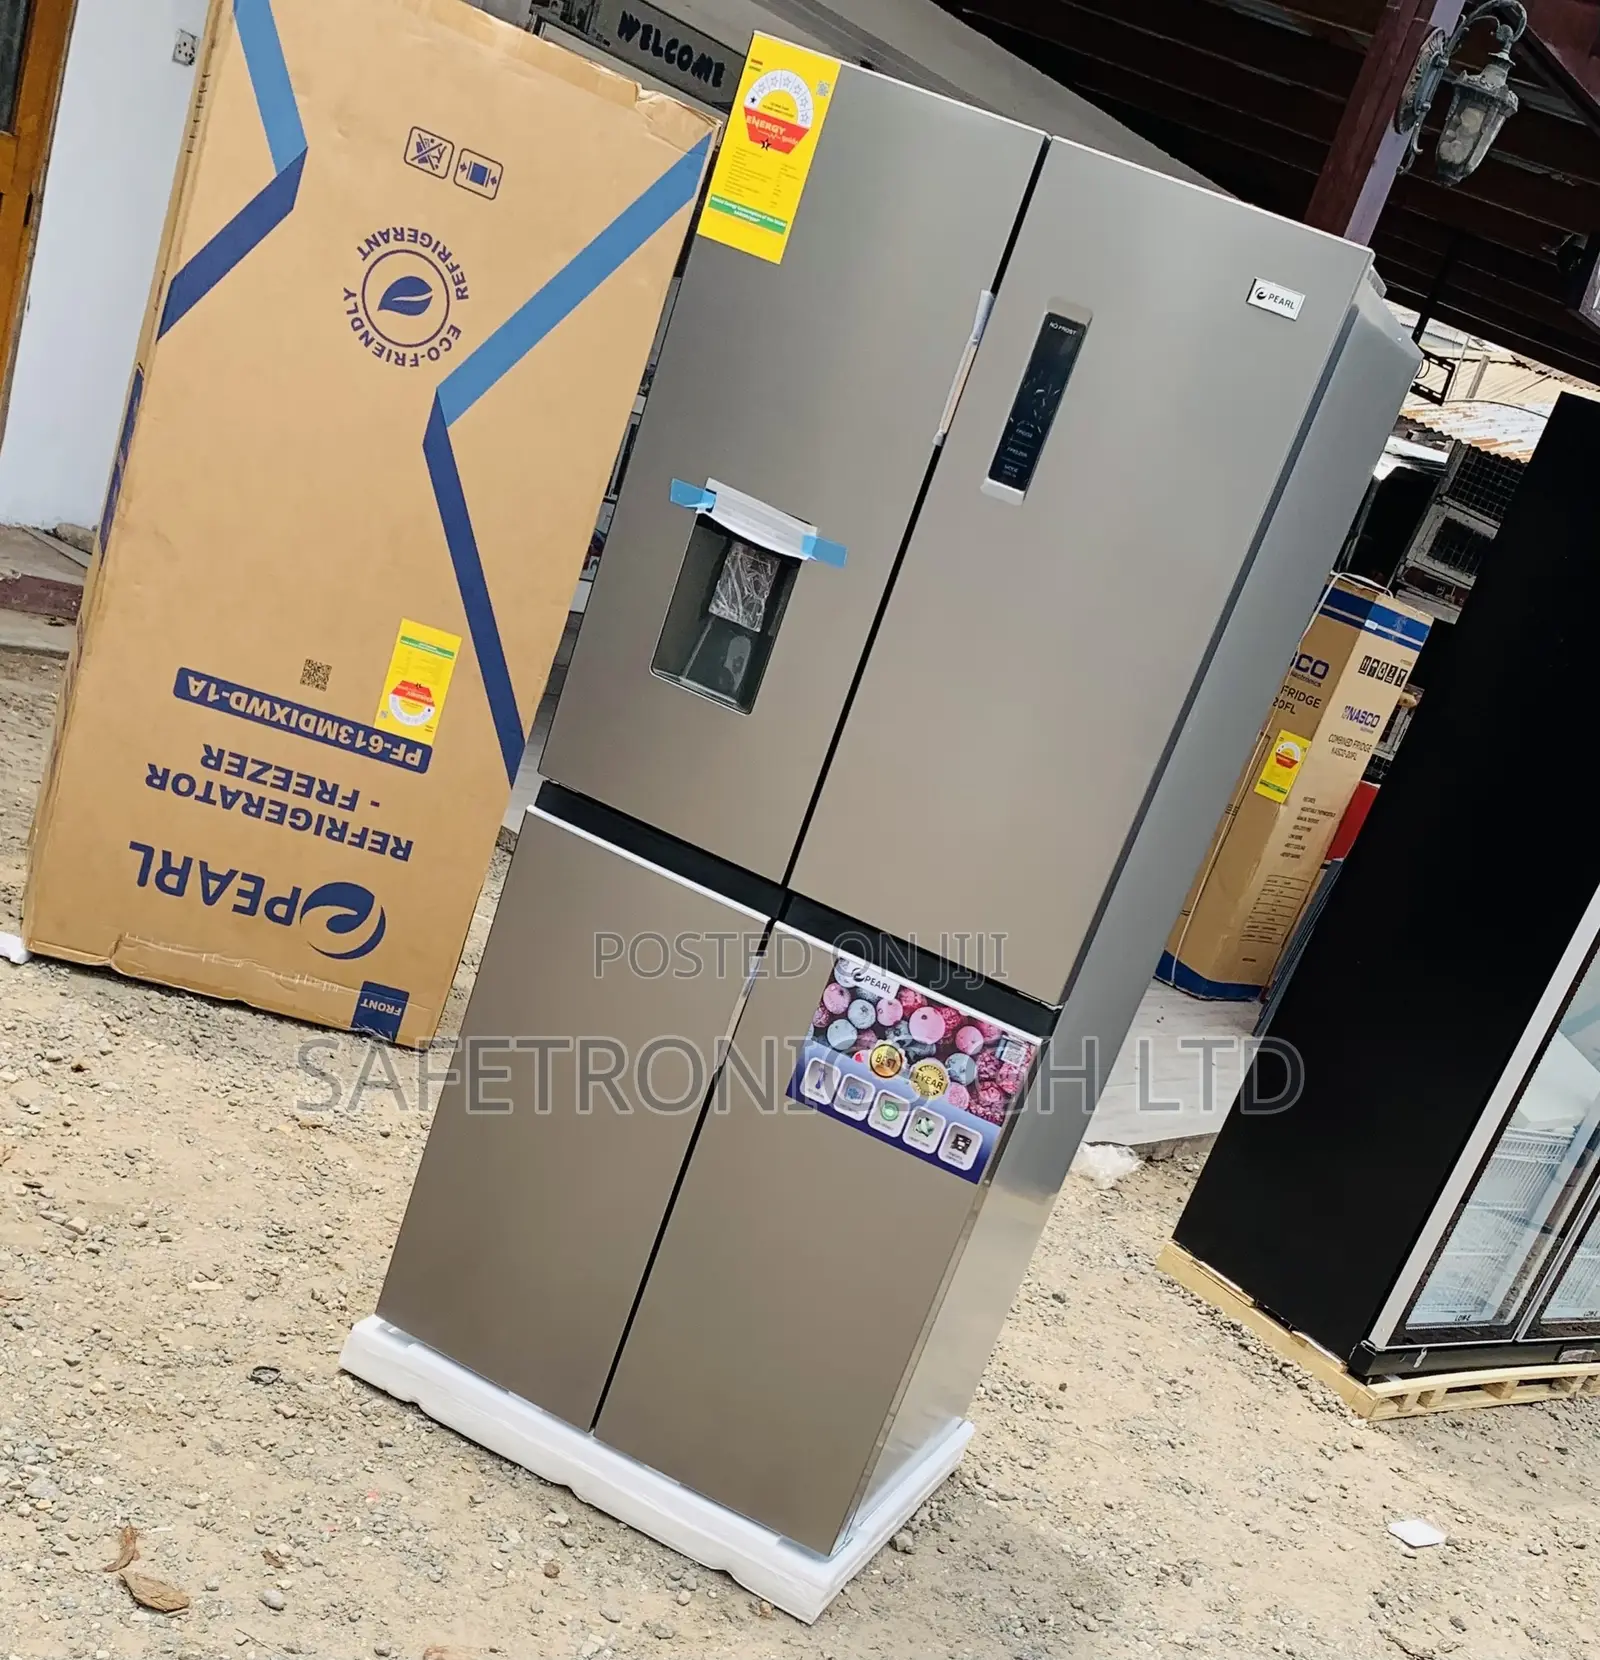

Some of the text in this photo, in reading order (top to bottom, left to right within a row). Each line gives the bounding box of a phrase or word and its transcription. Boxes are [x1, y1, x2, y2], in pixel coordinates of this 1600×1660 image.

[617, 10, 726, 88] WELCOME
[356, 227, 469, 300] REFRIGERANT
[1268, 293, 1295, 310] PEARL
[343, 287, 462, 368] ECO-FRIENDLY
[1280, 685, 1322, 709] FRIDGE
[1346, 706, 1381, 728] NASCO
[187, 674, 424, 768] PF-613MDIXWD-1A
[200, 743, 360, 812] FREEZER
[145, 763, 414, 862] REFRIGERATOR
[129, 841, 302, 927] PEARL
[360, 998, 402, 1017] FRONT
[864, 975, 891, 994] PEARL
[875, 1053, 896, 1070] BEST
[920, 1074, 944, 1089] YEAR
